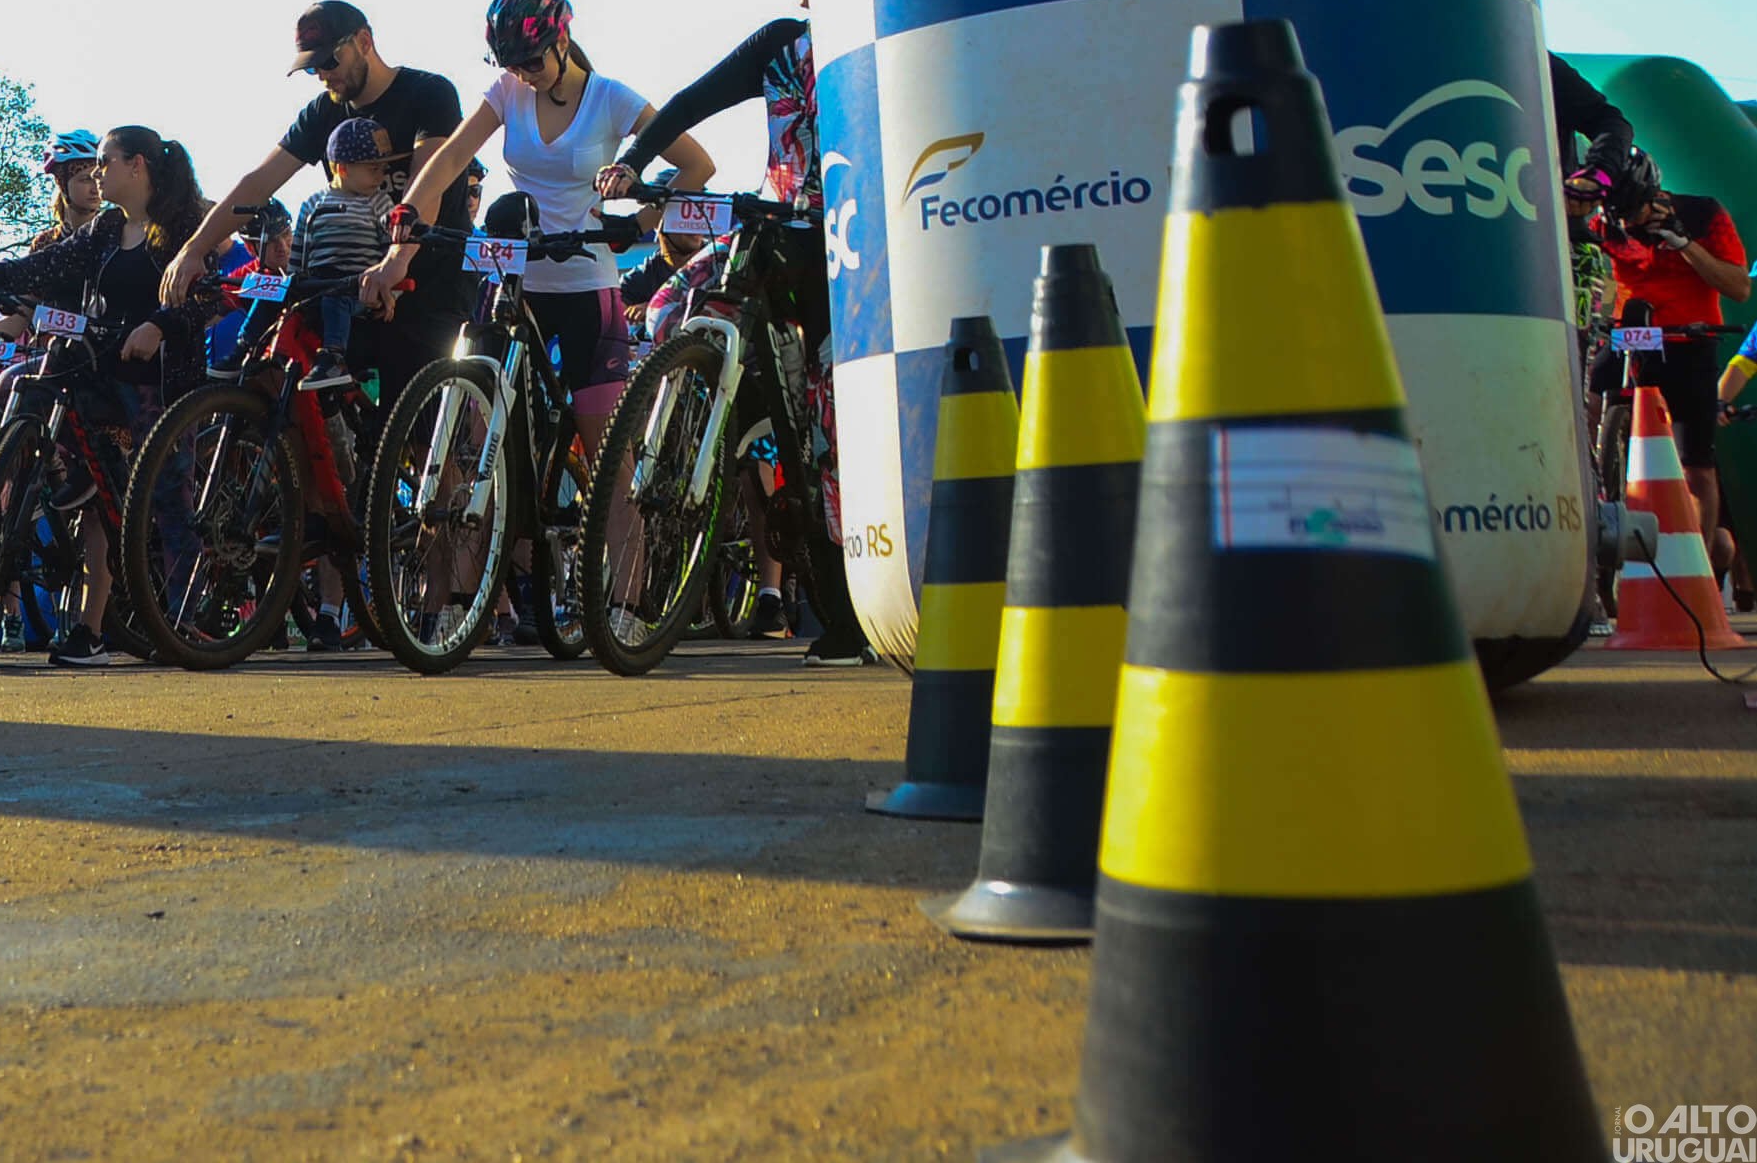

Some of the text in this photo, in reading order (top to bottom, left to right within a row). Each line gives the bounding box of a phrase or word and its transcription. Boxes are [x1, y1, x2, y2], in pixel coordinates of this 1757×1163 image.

[920, 170, 1152, 231] Fecomércio
[46, 309, 77, 329] 133
[1437, 493, 1582, 533] mércio RS
[866, 523, 893, 557] RS
